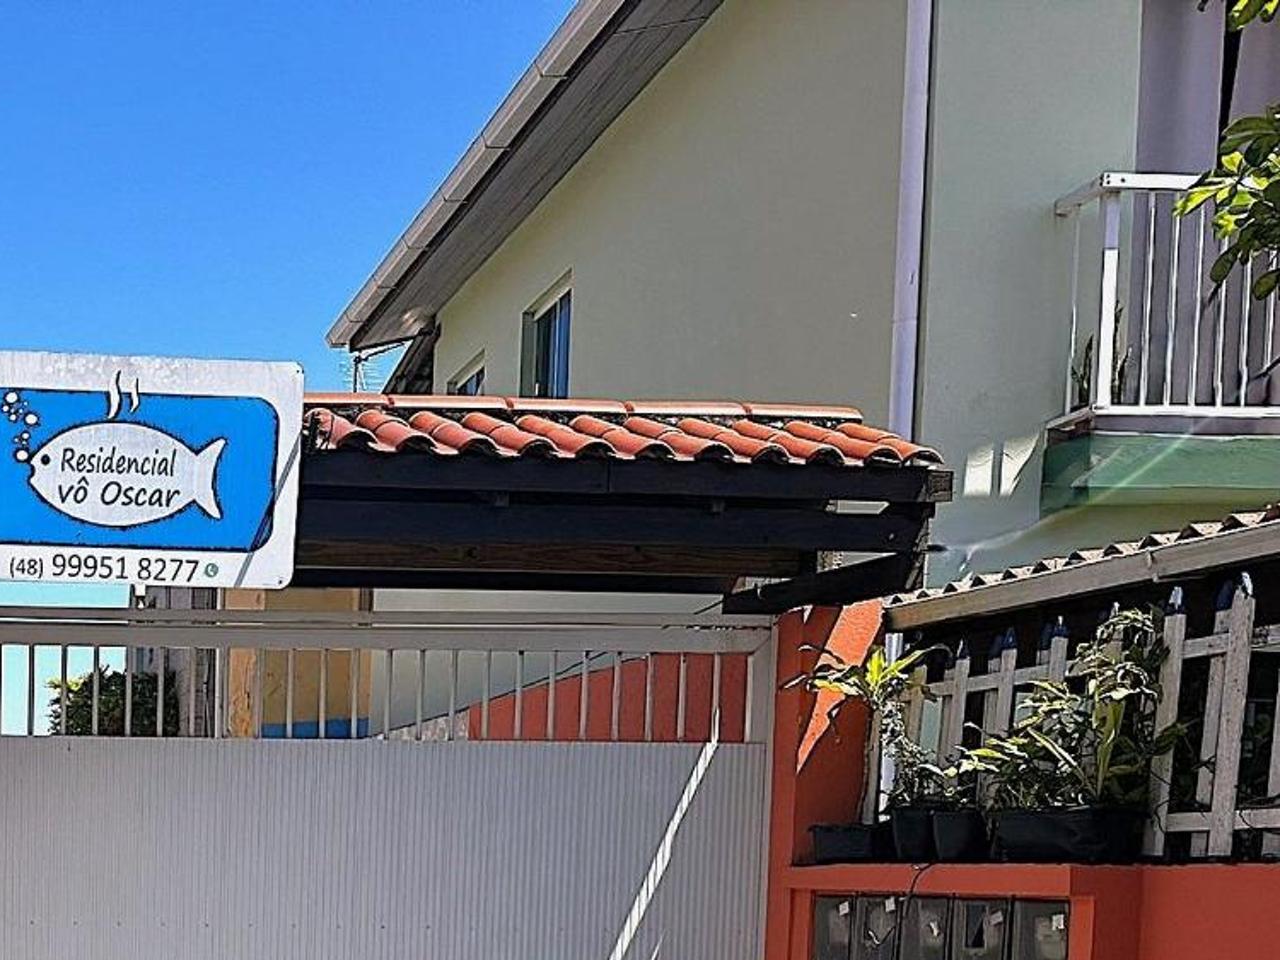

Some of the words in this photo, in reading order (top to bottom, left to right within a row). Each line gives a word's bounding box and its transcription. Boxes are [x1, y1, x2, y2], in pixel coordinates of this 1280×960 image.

[60, 448, 176, 477] Residencial
[58, 477, 89, 504] vô
[101, 481, 181, 508] Oscar
[9, 556, 44, 578] (48)
[52, 554, 129, 580] 99951
[137, 558, 200, 582] 8277
